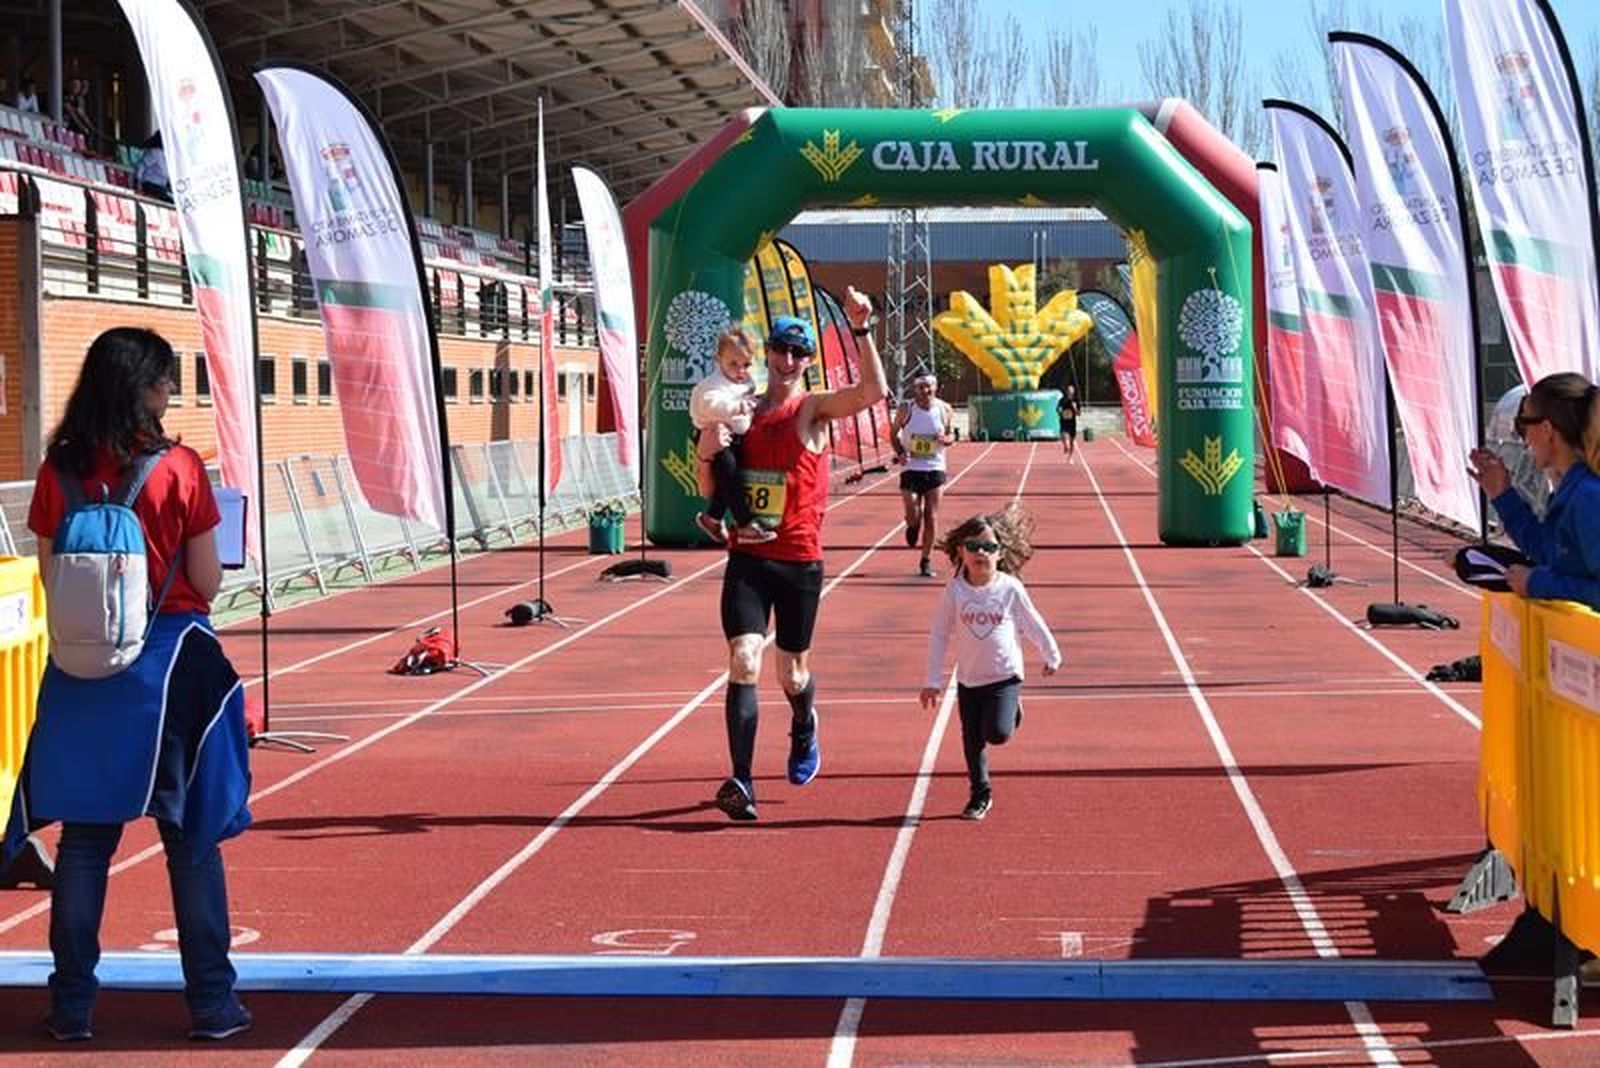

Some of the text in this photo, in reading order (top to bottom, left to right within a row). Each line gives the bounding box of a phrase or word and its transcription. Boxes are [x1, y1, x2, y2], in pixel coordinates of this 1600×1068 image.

[872, 141, 1099, 172] CAJA RURAL
[960, 611, 1003, 625] WOW
